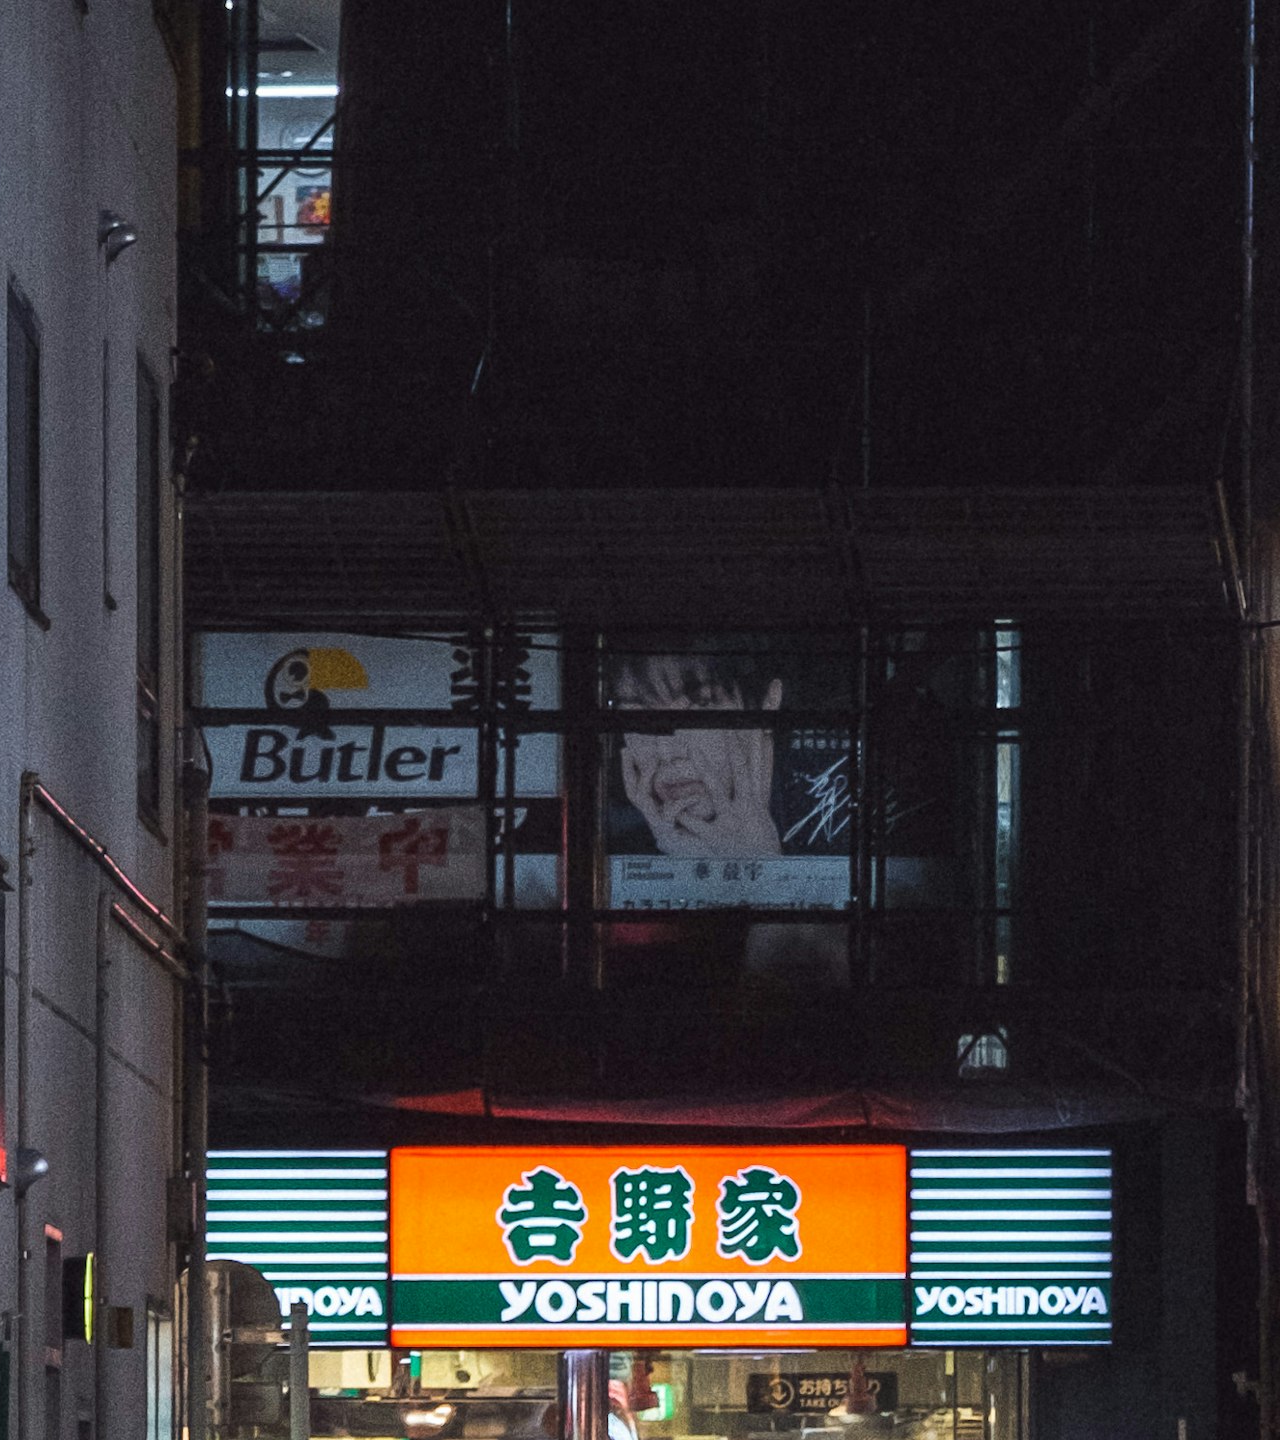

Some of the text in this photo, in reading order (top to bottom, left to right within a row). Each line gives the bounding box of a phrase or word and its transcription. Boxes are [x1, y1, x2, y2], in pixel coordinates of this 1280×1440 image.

[238, 725, 462, 784] Butler
[496, 1166, 804, 1266] 吉野家
[499, 1279, 804, 1323] YOSHINOYA
[914, 1285, 1108, 1316] YOSHINOYA
[799, 1397, 826, 1409] TAKE
